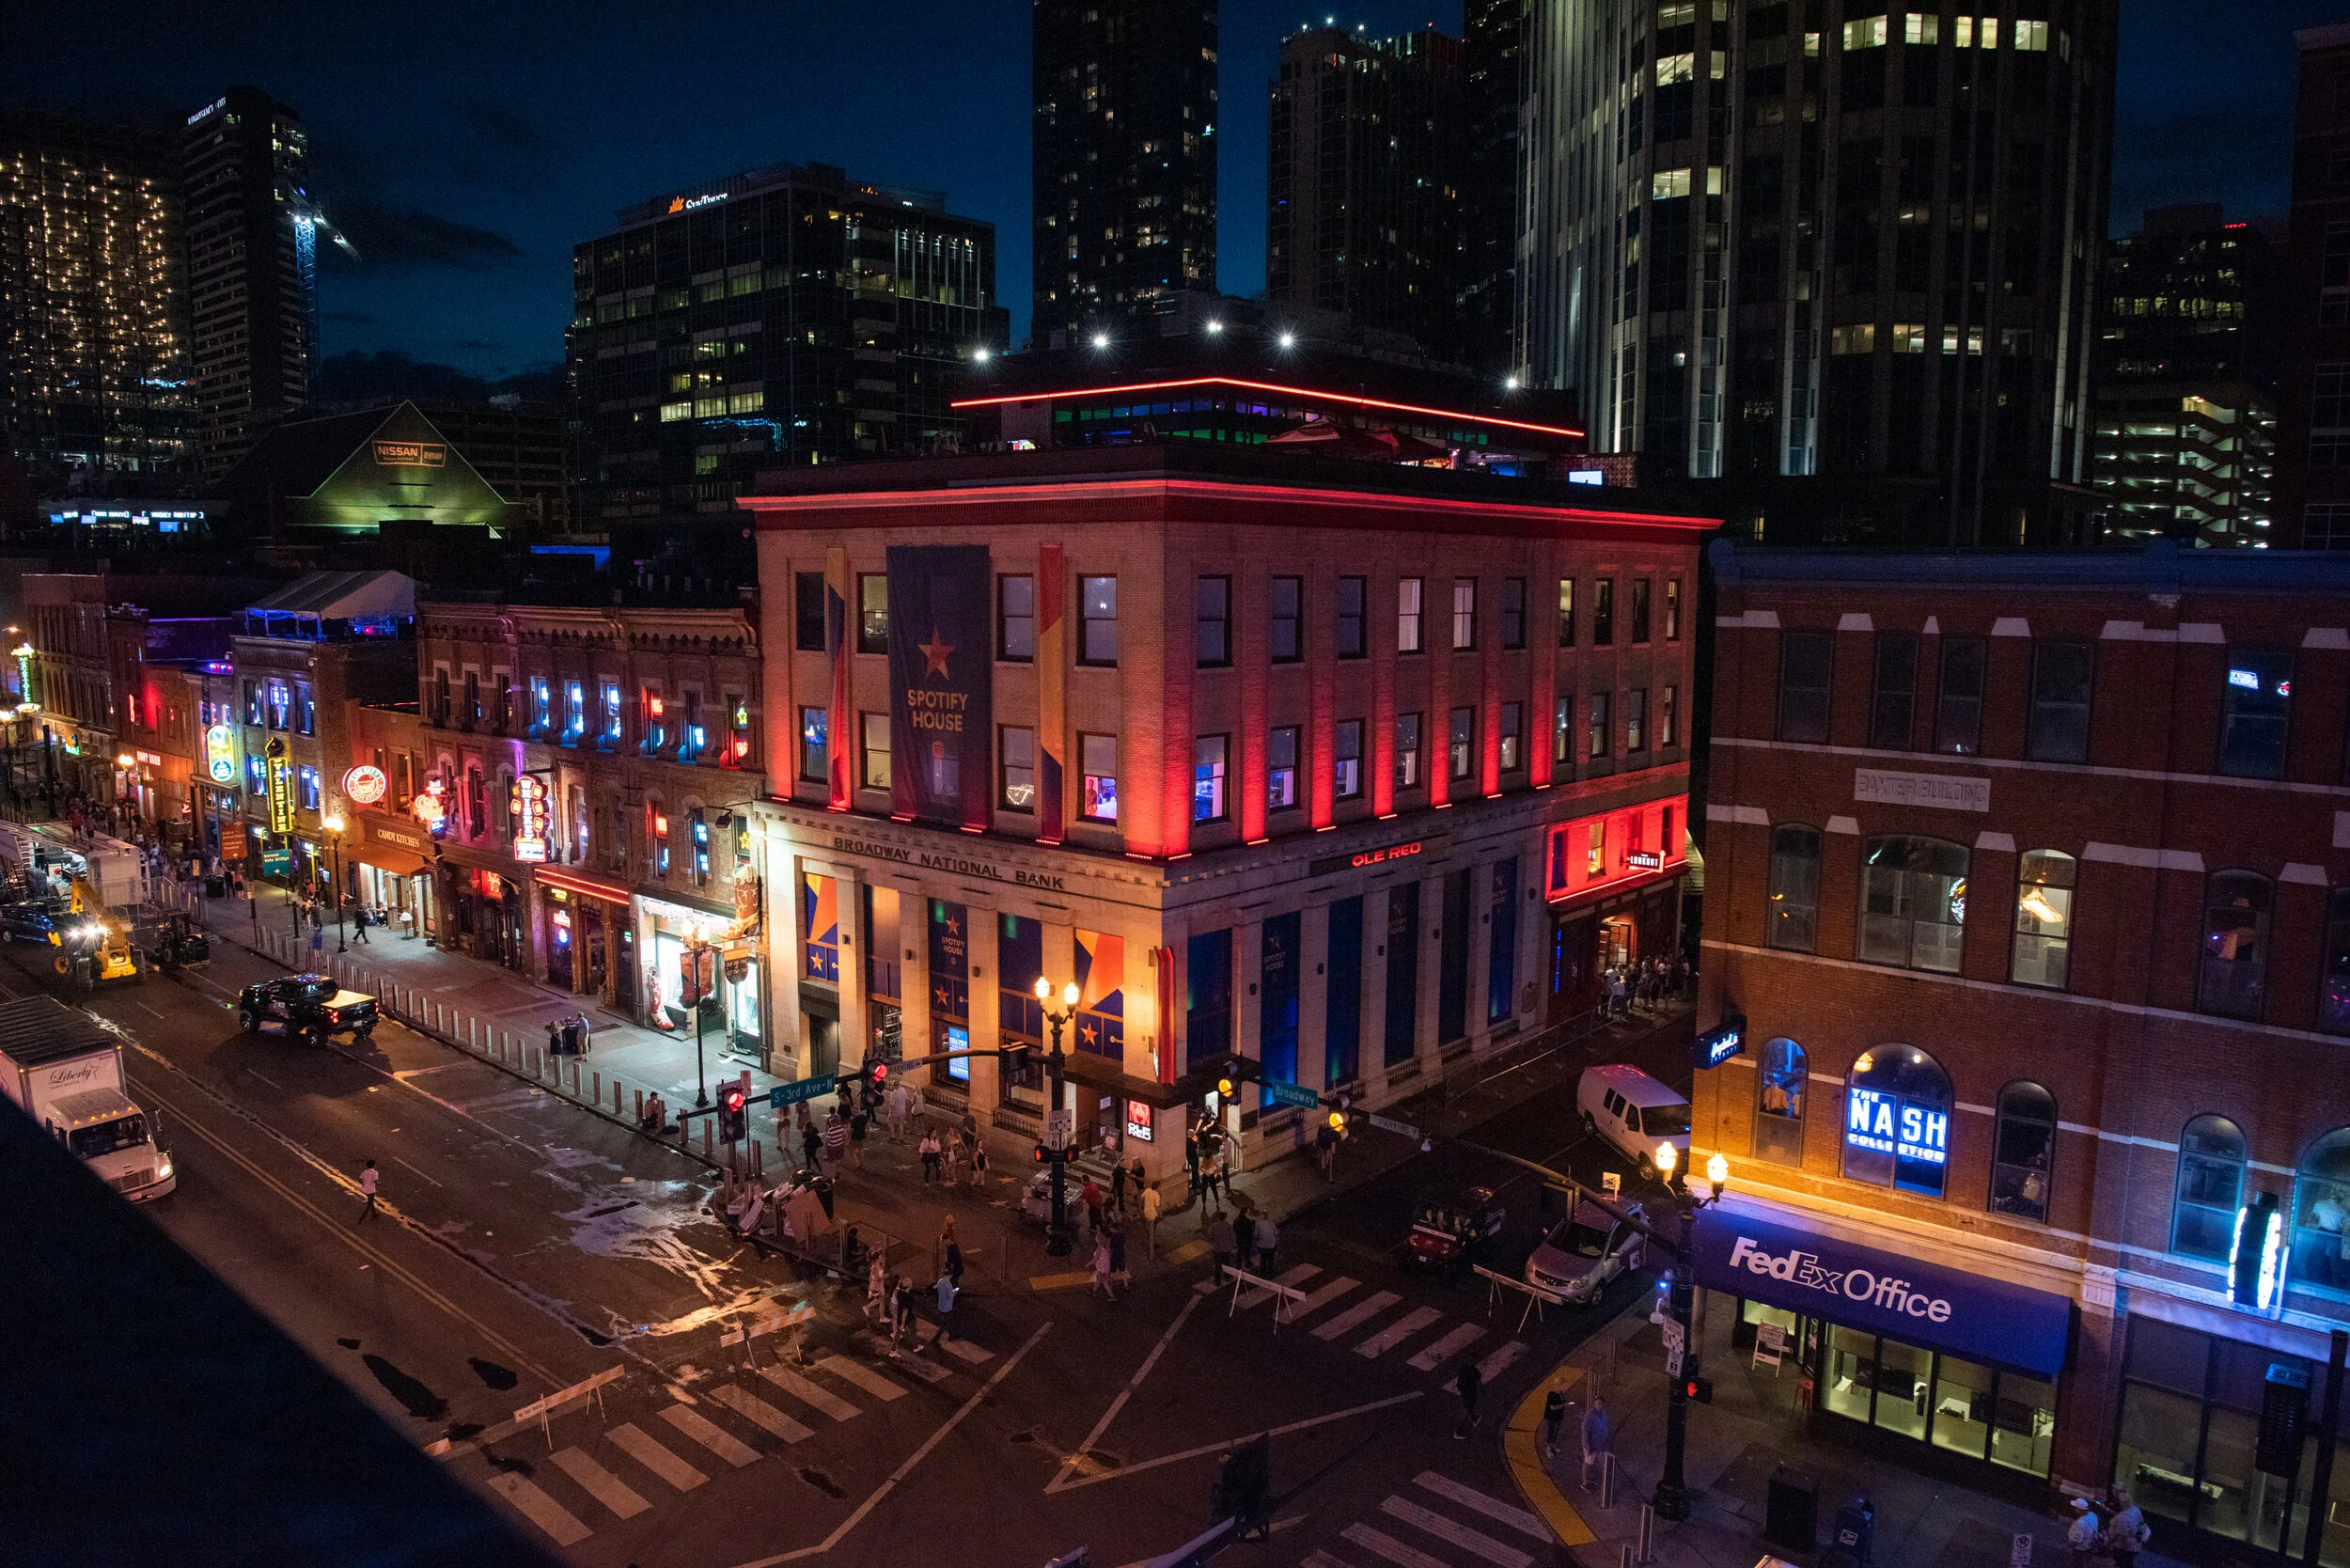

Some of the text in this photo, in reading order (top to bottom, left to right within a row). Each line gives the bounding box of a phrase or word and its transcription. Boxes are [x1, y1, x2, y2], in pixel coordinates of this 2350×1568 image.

[377, 445, 418, 457] NISSAN
[907, 689, 968, 711] SPOTIFY
[913, 711, 964, 732] HOUSE
[273, 763, 287, 832] VALENTINE
[1920, 780, 1986, 802] BUILDING
[377, 828, 420, 849] CANDY KITCHEN
[834, 837, 1065, 889] BROADWAY NATIONAL BANK
[1351, 841, 1422, 868] OLE RED
[1629, 855, 1659, 868] LOOKOUT
[941, 935, 965, 949] SPOTIFY
[943, 944, 964, 957] HOUSE
[49, 1067, 92, 1083] Liberty
[774, 1078, 834, 1104] S-3rd Ave-N
[1275, 1086, 1315, 1105] Broadway
[1852, 1088, 1879, 1102] THE
[1128, 1122, 1152, 1133] OLE
[1378, 1119, 1411, 1136] PARKING
[1851, 1099, 1947, 1149] NASH
[1128, 1129, 1152, 1141] RED
[1848, 1133, 1946, 1164] COLLECTION
[1729, 1236, 1951, 1323] FedEx Office
